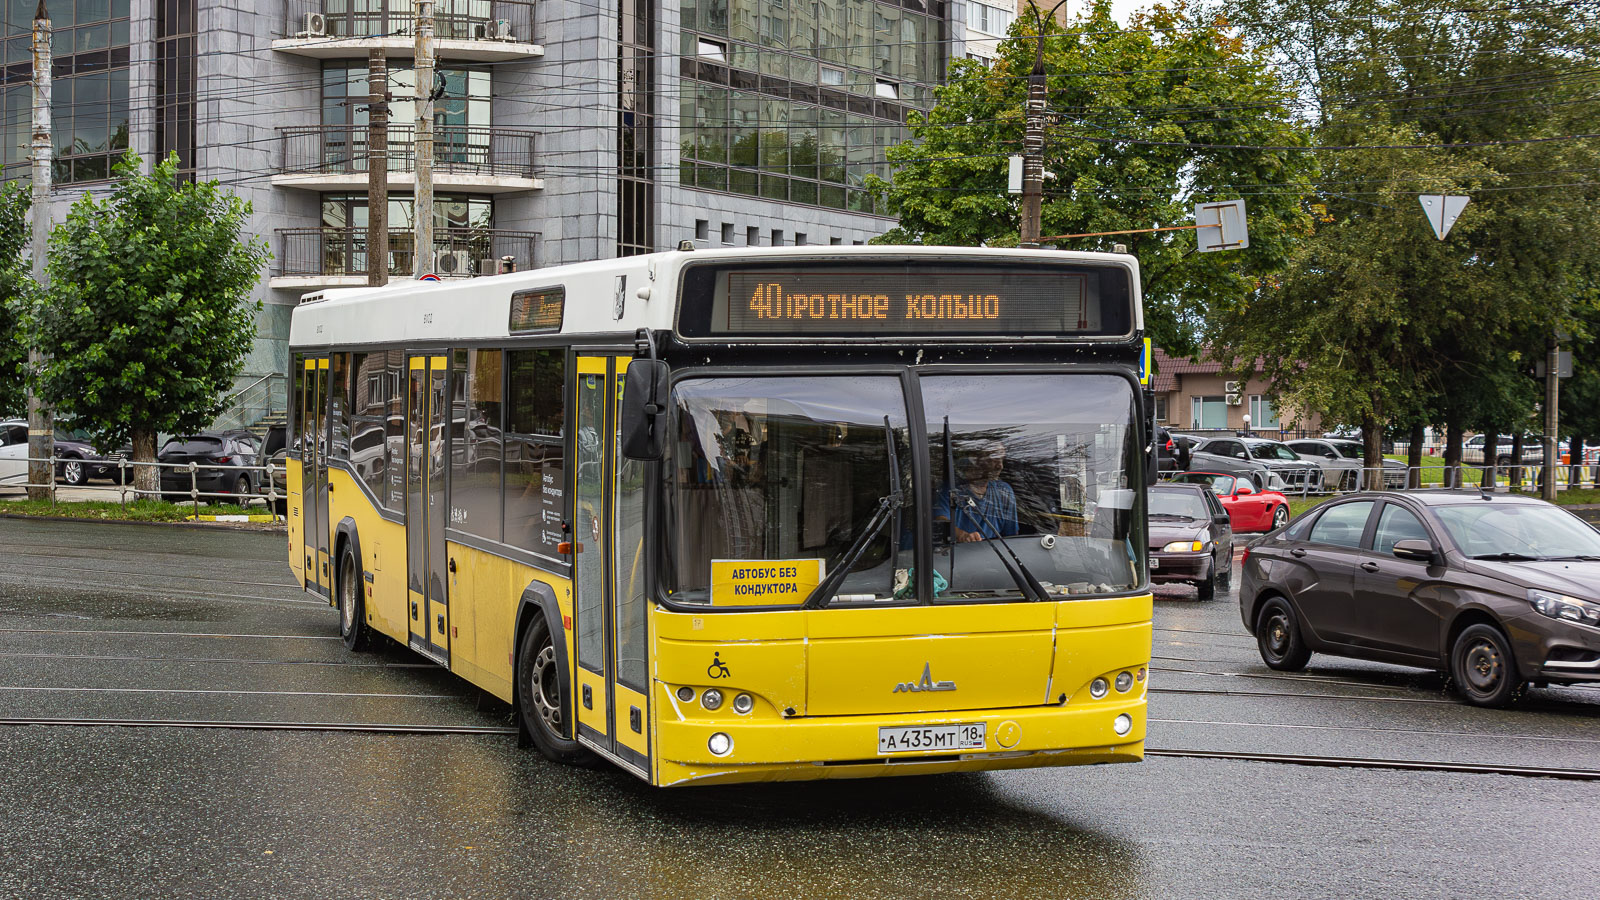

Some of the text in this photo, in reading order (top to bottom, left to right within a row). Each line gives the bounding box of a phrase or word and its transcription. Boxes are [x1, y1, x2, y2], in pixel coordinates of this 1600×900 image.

[749, 283, 782, 319] 40
[732, 567, 797, 579] АВТОБУС БЕЗ
[734, 583, 798, 596] КОНДУКТОРА
[962, 726, 978, 740] 18
